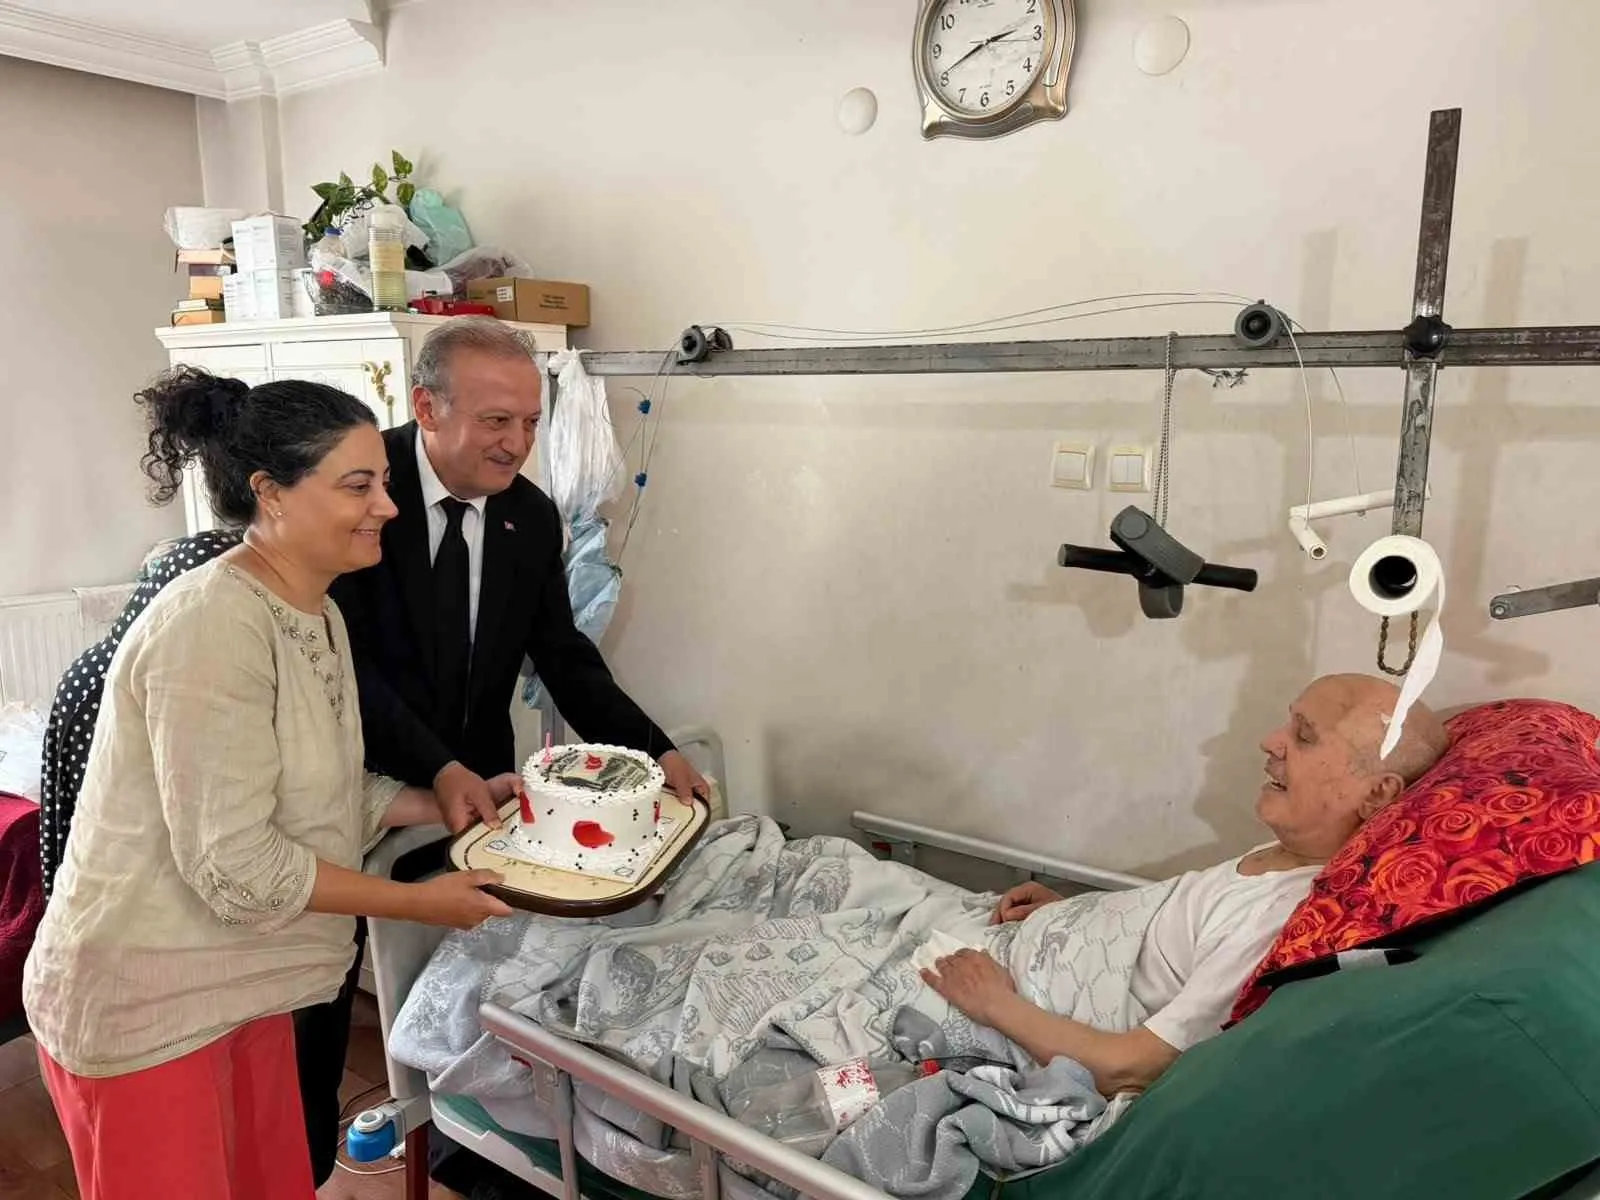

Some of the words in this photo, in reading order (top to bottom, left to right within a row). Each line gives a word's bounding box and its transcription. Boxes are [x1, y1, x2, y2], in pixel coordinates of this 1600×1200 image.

[1026, 0, 1036, 14] 2
[941, 14, 955, 31] 10
[1033, 25, 1042, 41] 3
[932, 44, 942, 59] 9
[1023, 57, 1032, 73] 4
[941, 71, 949, 87] 8
[958, 88, 967, 104] 7
[1006, 80, 1015, 96] 5
[980, 92, 990, 107] 6
